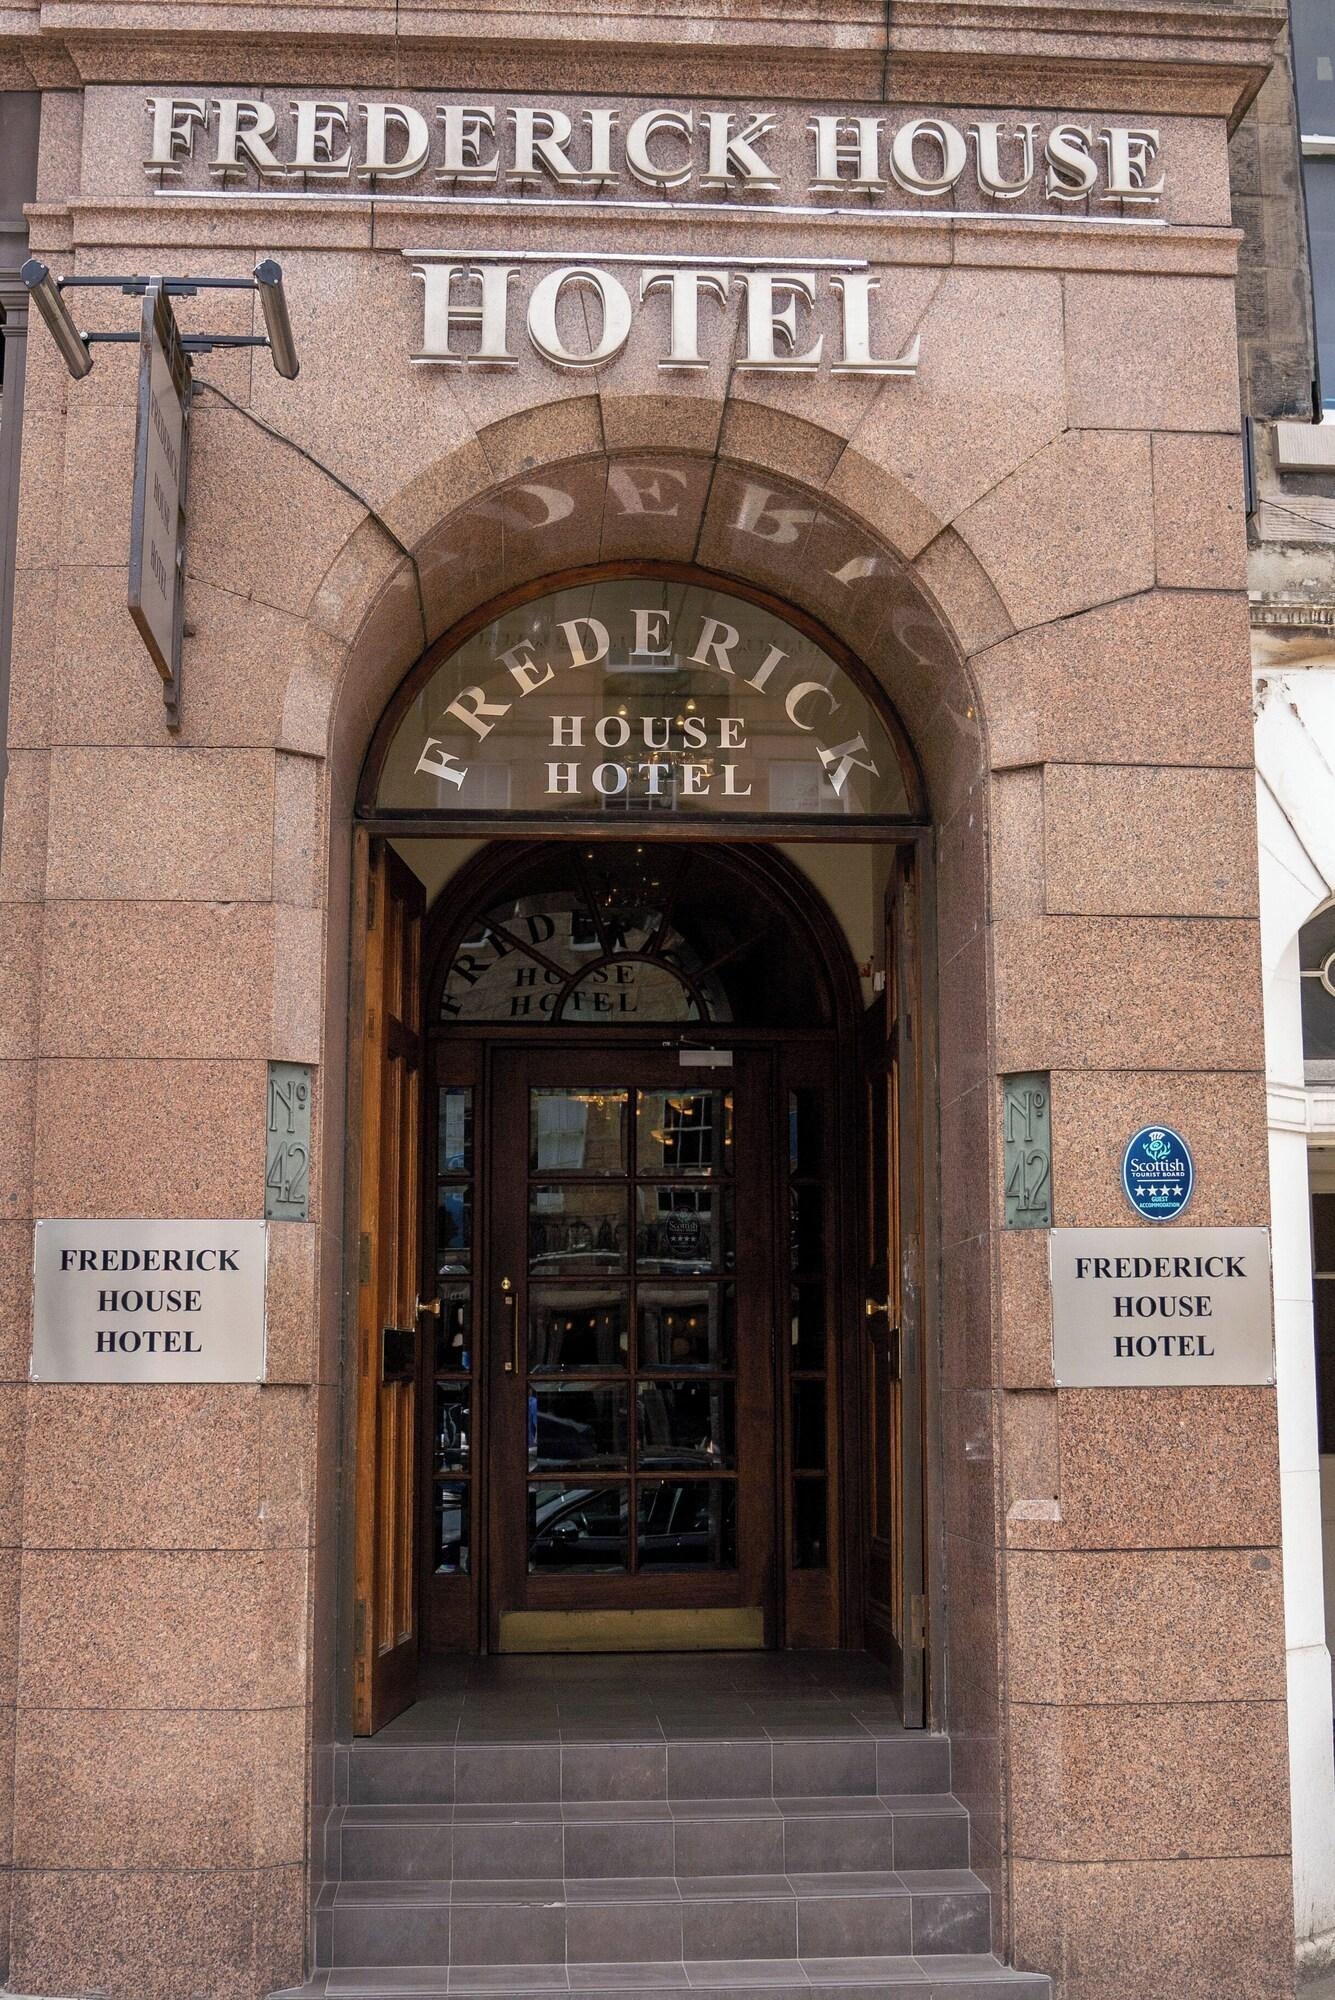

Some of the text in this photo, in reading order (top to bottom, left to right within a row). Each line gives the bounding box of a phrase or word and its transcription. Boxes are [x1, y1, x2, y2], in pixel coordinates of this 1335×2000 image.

[143, 96, 1166, 203] FREDERICK HOUSE
[409, 263, 920, 375] HOTEL
[150, 539, 167, 601] HOTEL
[414, 609, 880, 797] FREDERICK
[548, 715, 747, 749] HOUSE
[544, 762, 752, 797] HOTEL
[516, 965, 635, 986] HOSE
[510, 992, 638, 1016] HOTEL
[266, 1141, 307, 1204] 42
[1131, 1158, 1185, 1172] Scottish
[1005, 1150, 1049, 1211] 42
[59, 1249, 241, 1272] FREDERICK
[1075, 1256, 1247, 1279] FREDERICK
[97, 1290, 202, 1312] HOUSE
[1113, 1296, 1213, 1318] HOUSE
[95, 1331, 203, 1353] HOTEL
[1113, 1335, 1215, 1358] HOTEL
